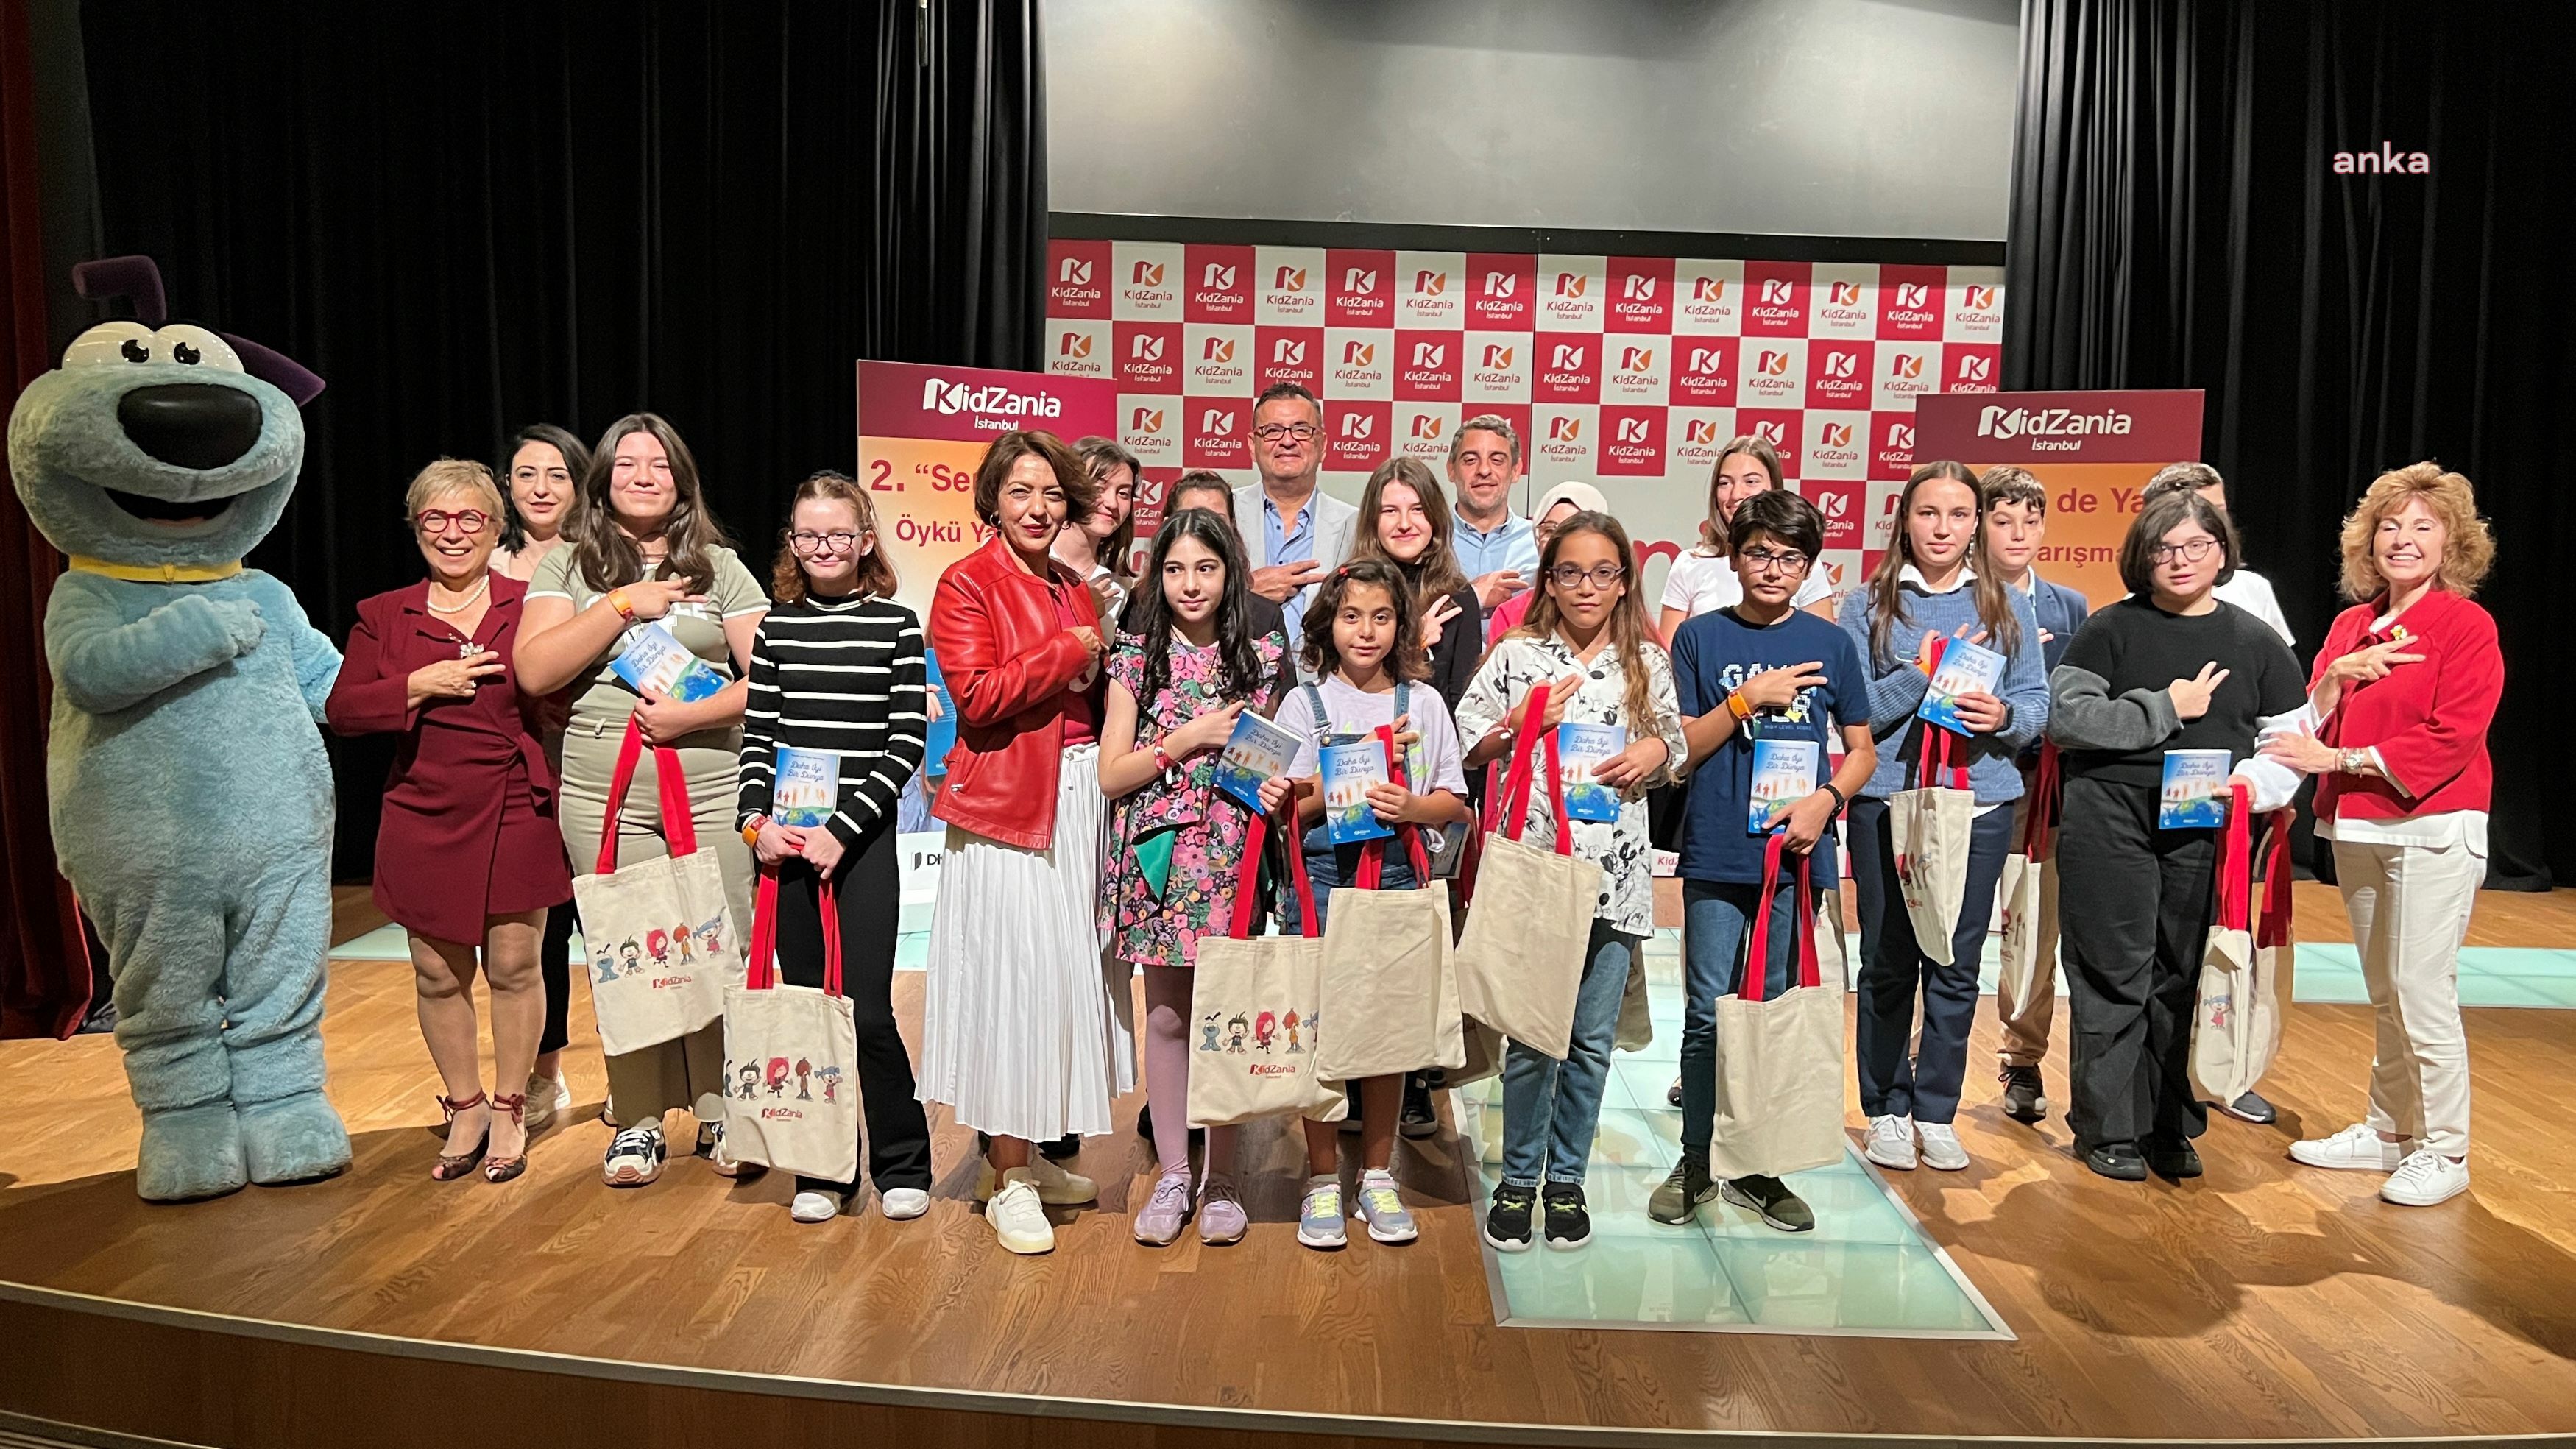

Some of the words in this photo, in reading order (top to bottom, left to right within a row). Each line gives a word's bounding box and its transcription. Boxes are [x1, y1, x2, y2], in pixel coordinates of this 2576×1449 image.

[1051, 287, 1101, 300] KidZania
[1124, 289, 1172, 302] KidZania
[1195, 291, 1243, 305] KidZania
[1266, 294, 1314, 306] KidZania
[1335, 296, 1383, 309] KidZania
[1406, 298, 1453, 311] KidZania
[1476, 300, 1523, 313] KidZania
[1546, 301, 1593, 313] KidZania
[1615, 302, 1662, 316] KidZania
[1684, 305, 1730, 317] KidZania
[1752, 307, 1799, 319] KidZania
[1821, 308, 1866, 321] KidZania
[1887, 311, 1933, 324] KidZania
[1955, 313, 2000, 325] KidZania
[1052, 360, 1100, 372] KidZania
[1123, 363, 1172, 375] KidZania
[1195, 365, 1242, 378] KidZania
[1265, 368, 1313, 380] KidZania
[1335, 369, 1381, 381] KidZania
[1404, 371, 1451, 383] KidZania
[1474, 372, 1520, 384] KidZania
[1543, 373, 1590, 386] KidZania
[1613, 375, 1658, 386] KidZania
[1680, 377, 1727, 389] KidZania
[1749, 378, 1794, 390] KidZania
[1816, 380, 1863, 392] KidZania
[1884, 381, 1929, 393] KidZania
[1951, 383, 1996, 394] KidZania
[922, 378, 1061, 418] KidZania
[974, 414, 1019, 431] İstanbul
[1978, 405, 2131, 439] KidZania
[1124, 436, 1171, 448] KidZania
[1194, 438, 1242, 450] KidZania
[1333, 441, 1380, 453] KidZania
[2031, 437, 2081, 451] İstanbul
[1403, 443, 1449, 455] KidZania
[1540, 444, 1587, 457] KidZania
[1608, 446, 1655, 458] KidZania
[1812, 450, 1858, 462] KidZania
[871, 459, 905, 492] 2.
[2056, 488, 2098, 513] de
[896, 514, 960, 548] Öykü
[1250, 1064, 1296, 1075] KidZania
